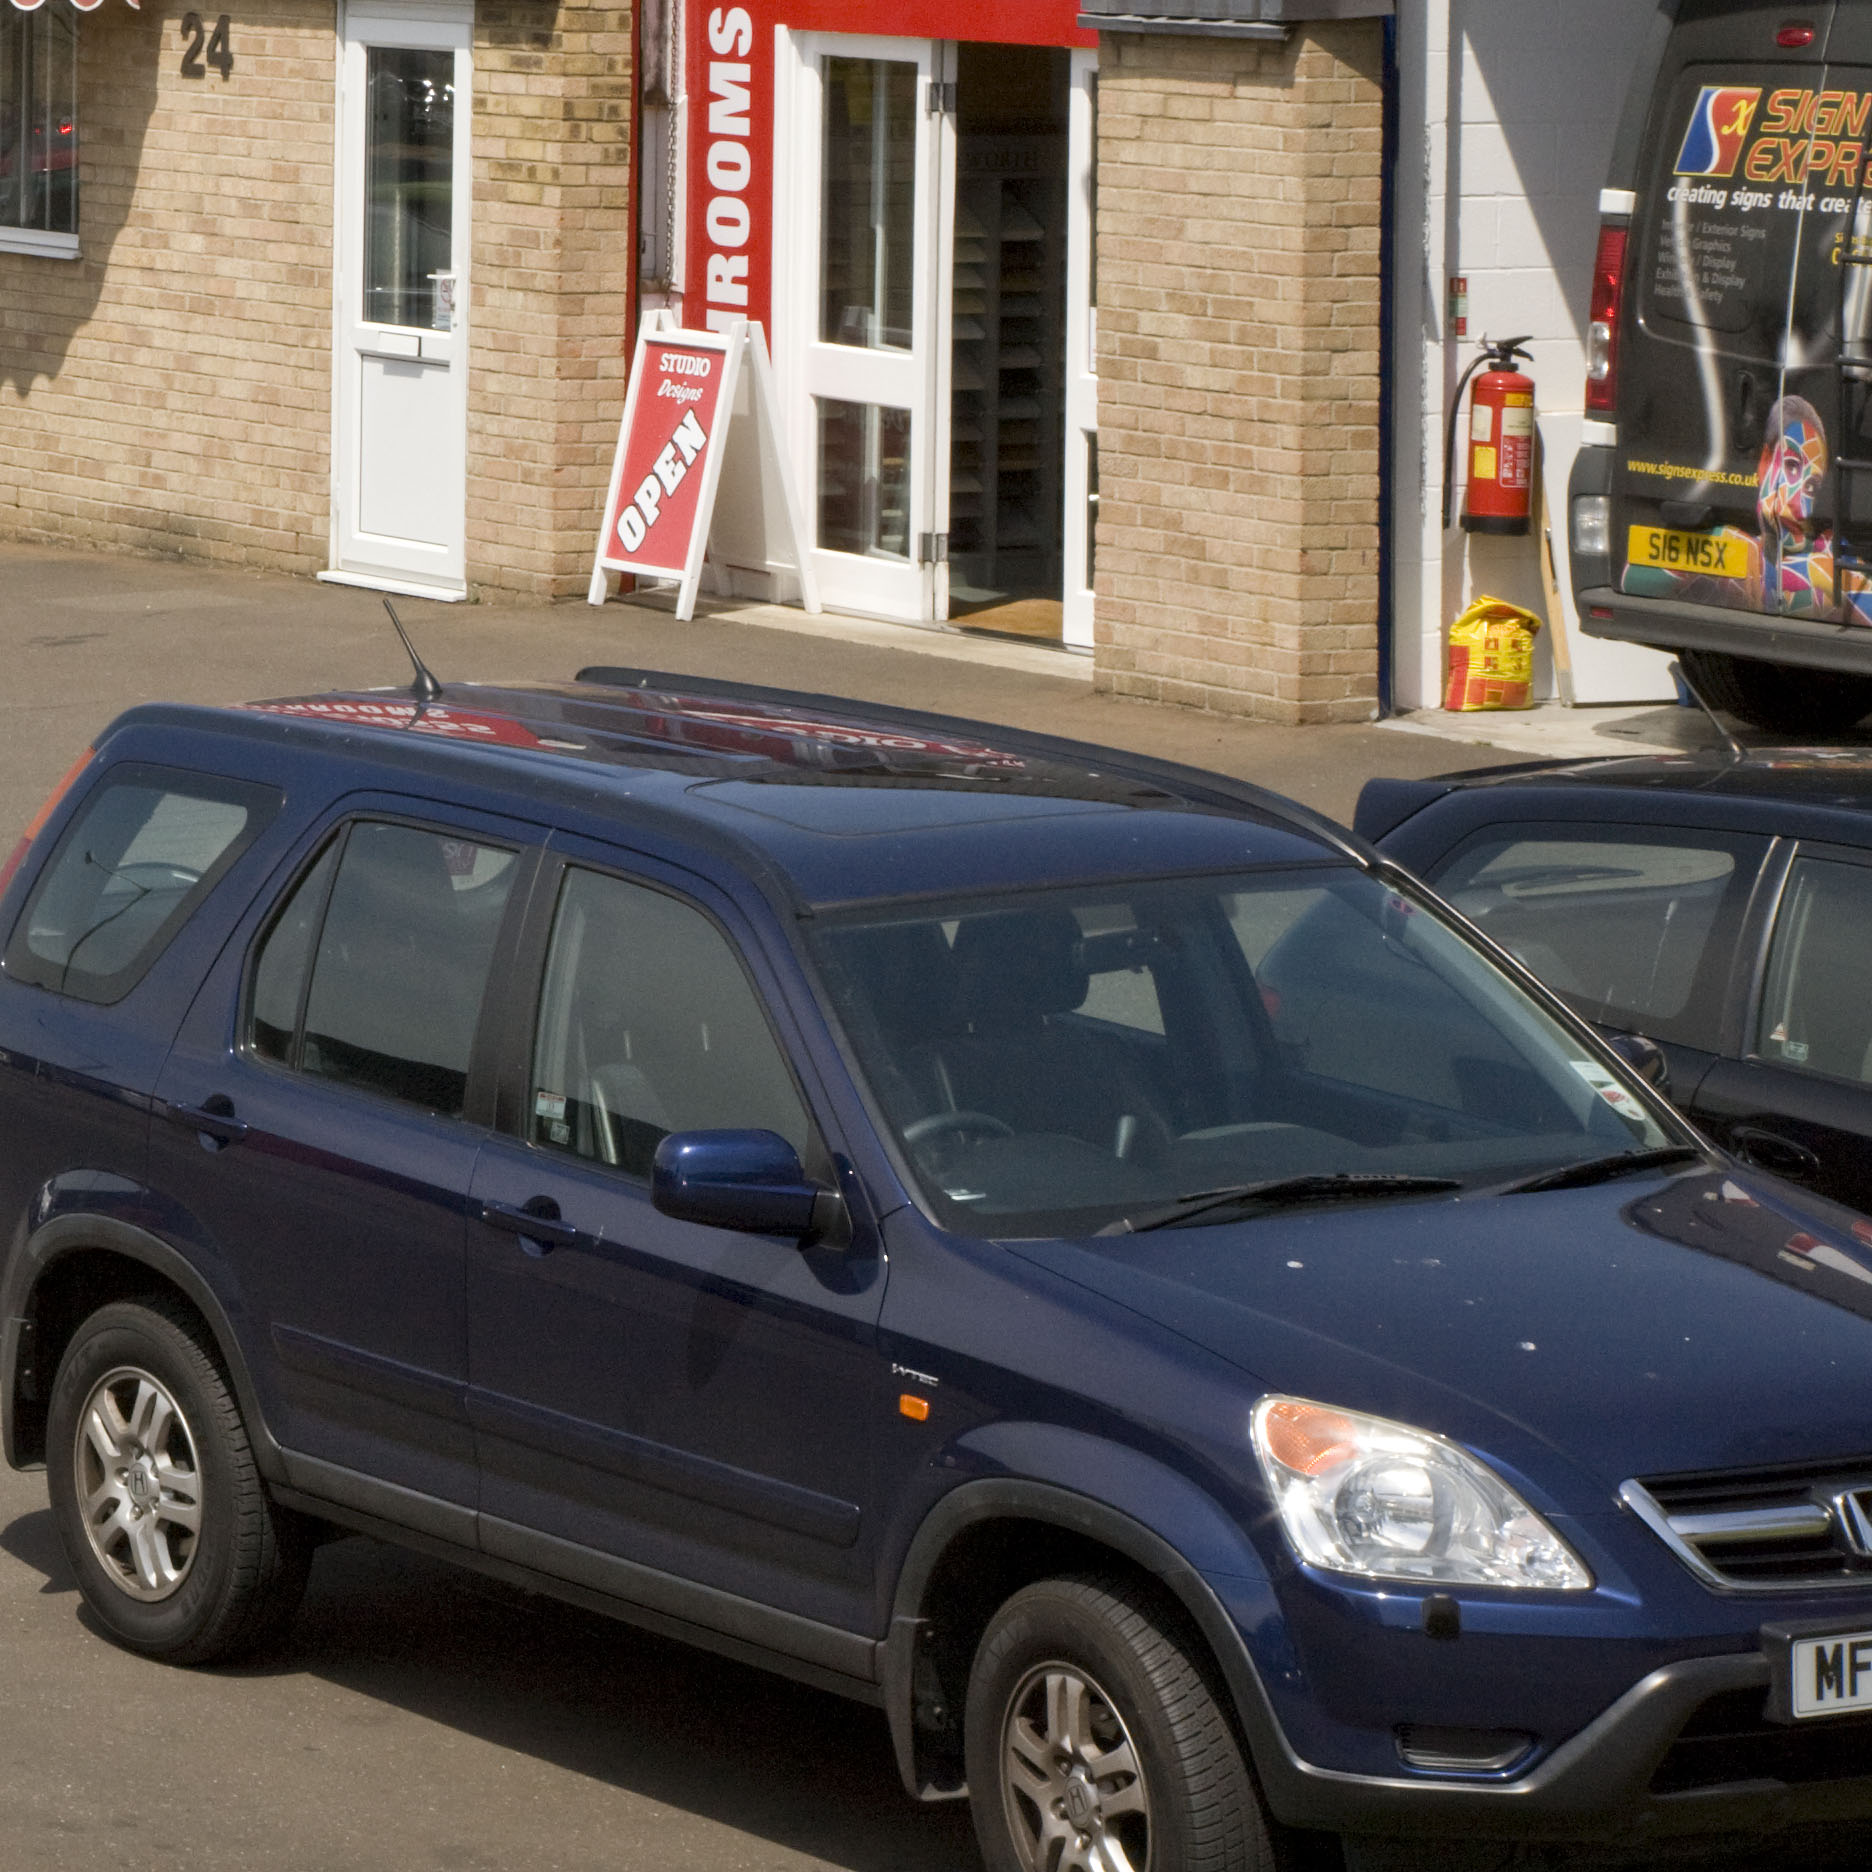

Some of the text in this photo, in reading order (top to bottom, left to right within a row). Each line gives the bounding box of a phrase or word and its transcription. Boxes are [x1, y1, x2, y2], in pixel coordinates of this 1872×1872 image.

[180, 12, 234, 79] 24
[1760, 89, 1872, 137] SIGN
[706, 6, 753, 329] ROOMS
[1667, 184, 1728, 210] creating
[1731, 186, 1773, 211] signs
[1778, 189, 1814, 211] that
[659, 351, 711, 378] STUDIO
[656, 378, 704, 404] Designs
[616, 408, 708, 554] OPEN
[1627, 460, 1759, 487] www.signsexpress.co.uk
[1648, 533, 1728, 570] S16 NSX
[1815, 1640, 1872, 1701] MF
